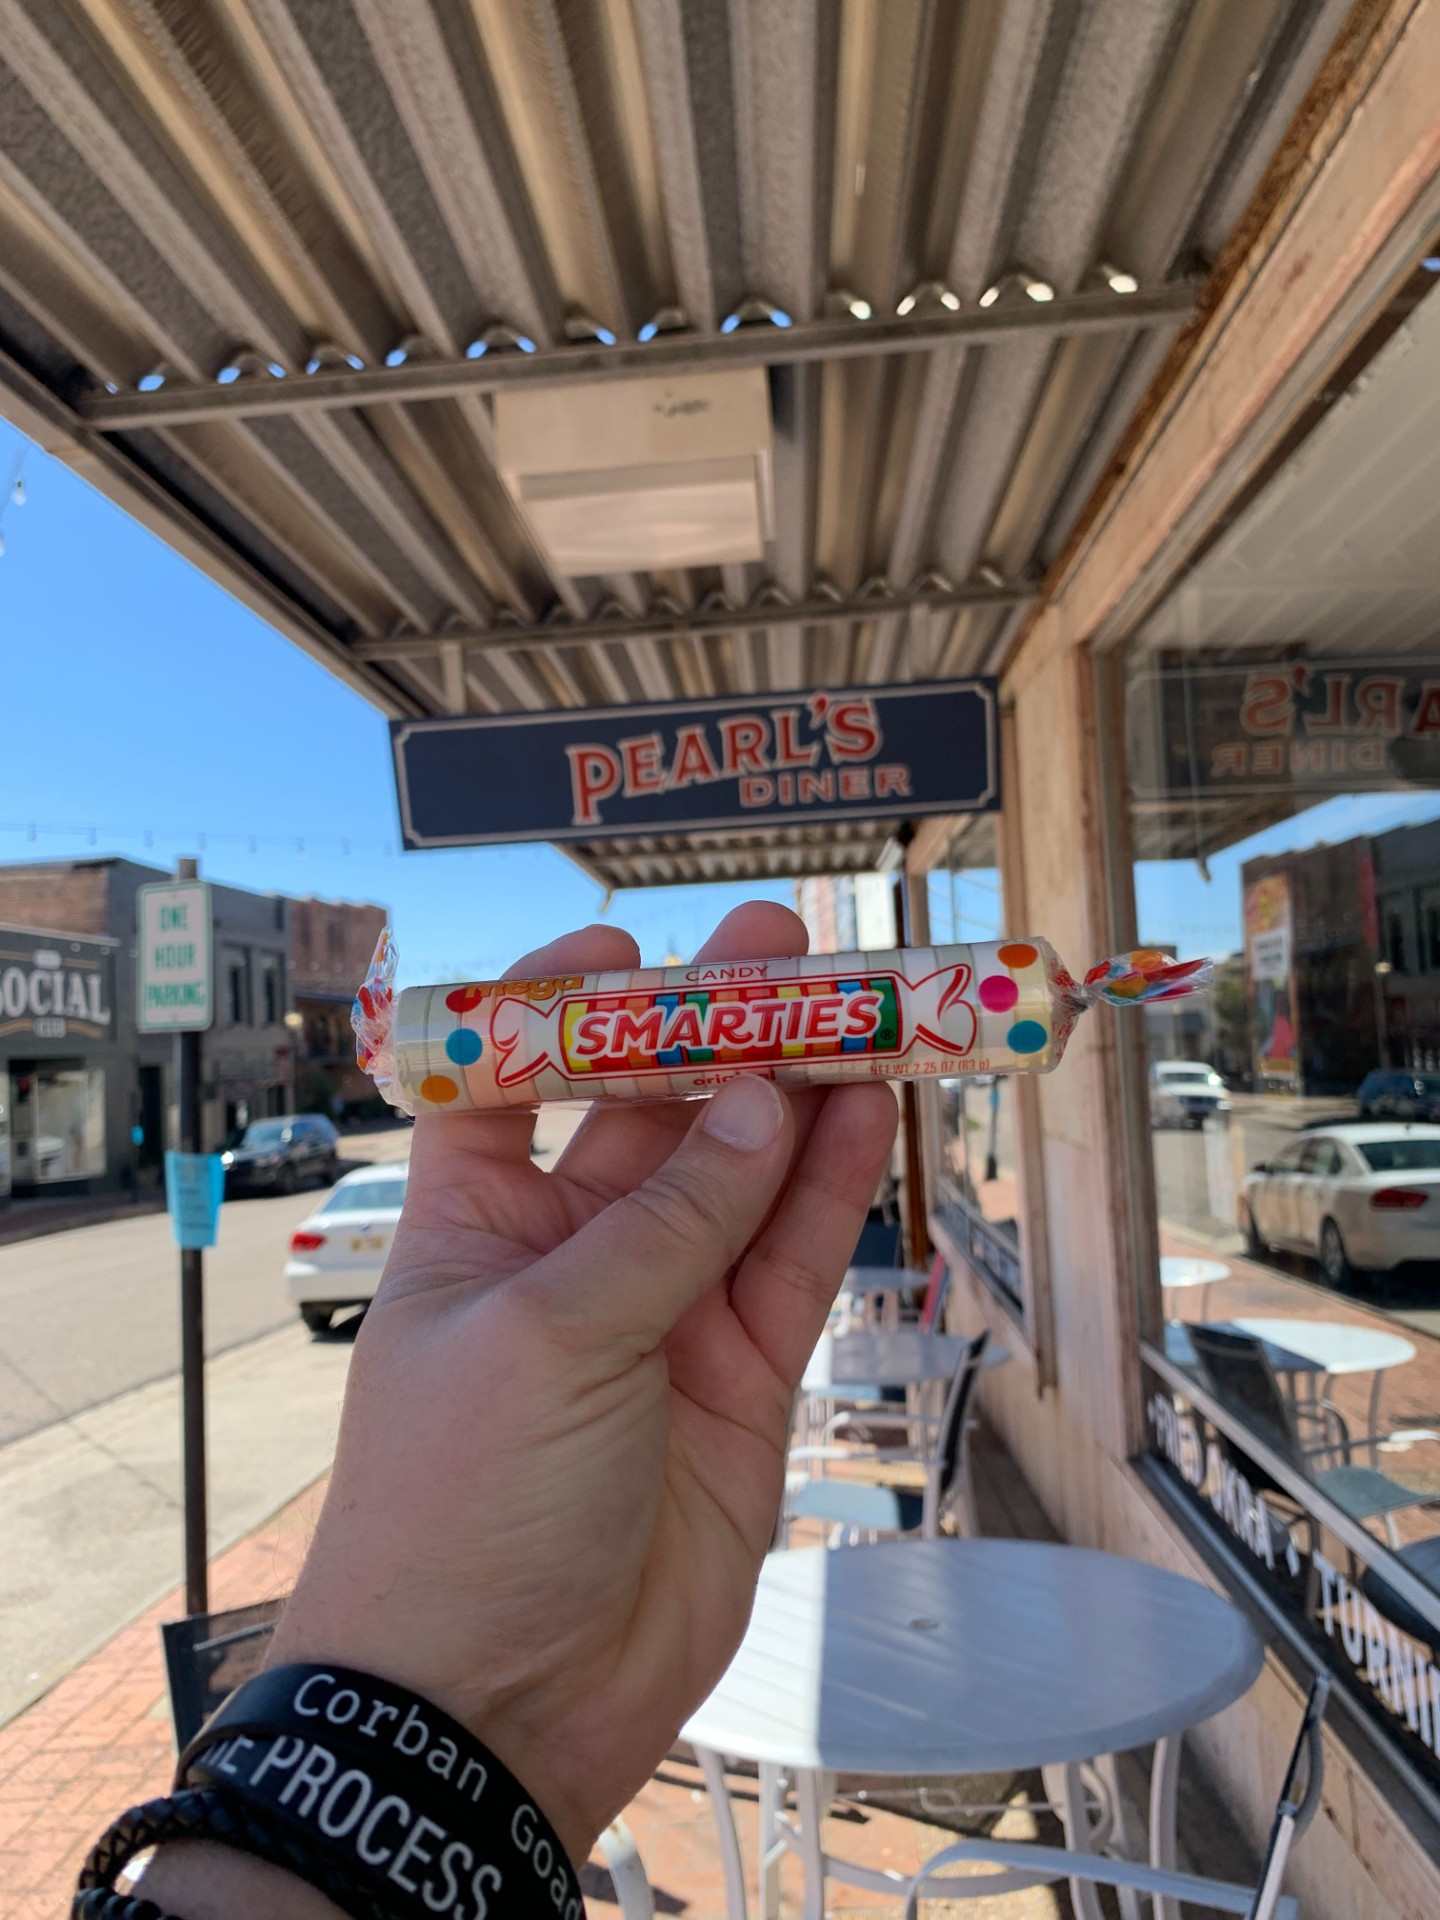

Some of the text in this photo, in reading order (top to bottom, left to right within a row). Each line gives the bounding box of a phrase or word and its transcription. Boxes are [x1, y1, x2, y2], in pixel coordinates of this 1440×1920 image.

[565, 692, 883, 826] PEARL'S
[739, 763, 913, 808] DINER
[160, 904, 188, 931] ONE
[154, 943, 194, 969] HOUR
[685, 966, 768, 981] CANDY
[0, 966, 111, 1026] OCIAL
[147, 981, 206, 1008] PARKING
[464, 976, 585, 1000] mega
[574, 995, 882, 1056] SMARTIES
[693, 1070, 777, 1086] orial
[869, 1064, 890, 1076] NET
[892, 1063, 909, 1075] WT
[913, 1061, 937, 1074] 2.25
[293, 1673, 488, 1802] Corban
[249, 1735, 503, 1920] PROCESS
